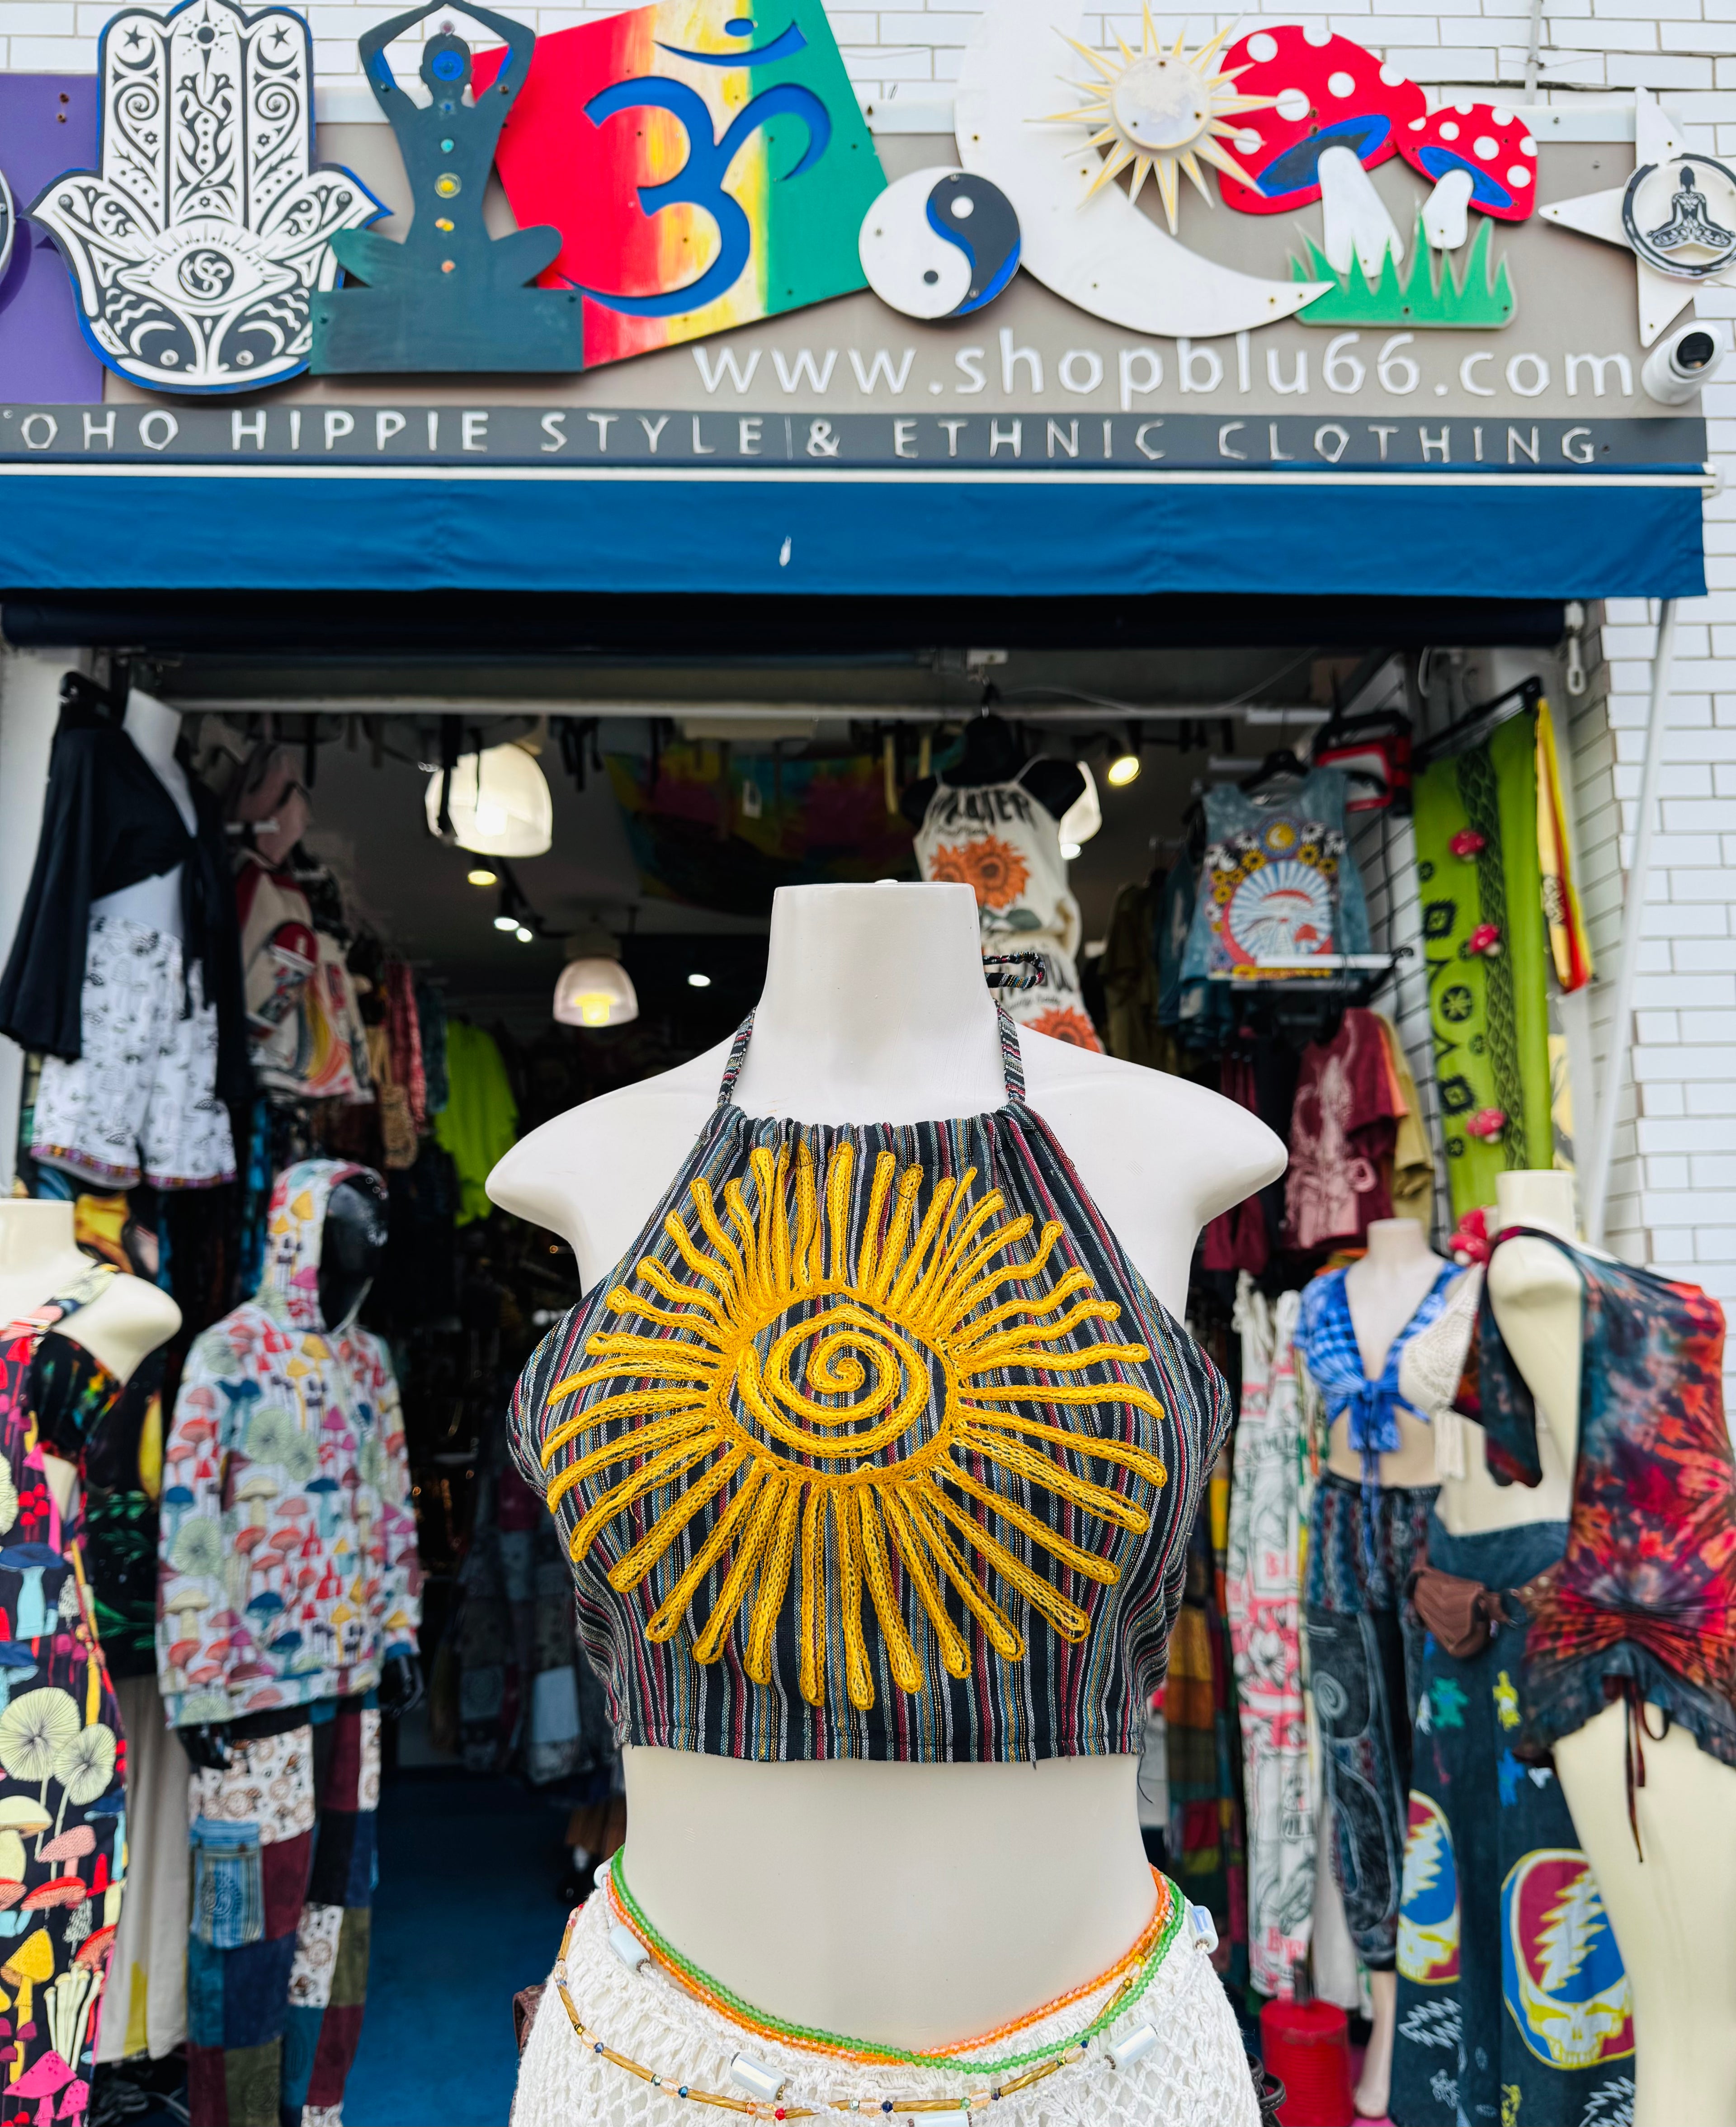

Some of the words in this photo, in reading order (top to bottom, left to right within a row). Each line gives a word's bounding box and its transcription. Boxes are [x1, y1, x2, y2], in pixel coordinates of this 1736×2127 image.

[693, 328, 1633, 412] www.shopblu66.com
[231, 410, 488, 451] HIPPIE
[540, 411, 763, 454] STYLE
[806, 419, 841, 457] &
[894, 418, 1165, 460] ETHNIC
[1219, 421, 1595, 463] CLOTHING
